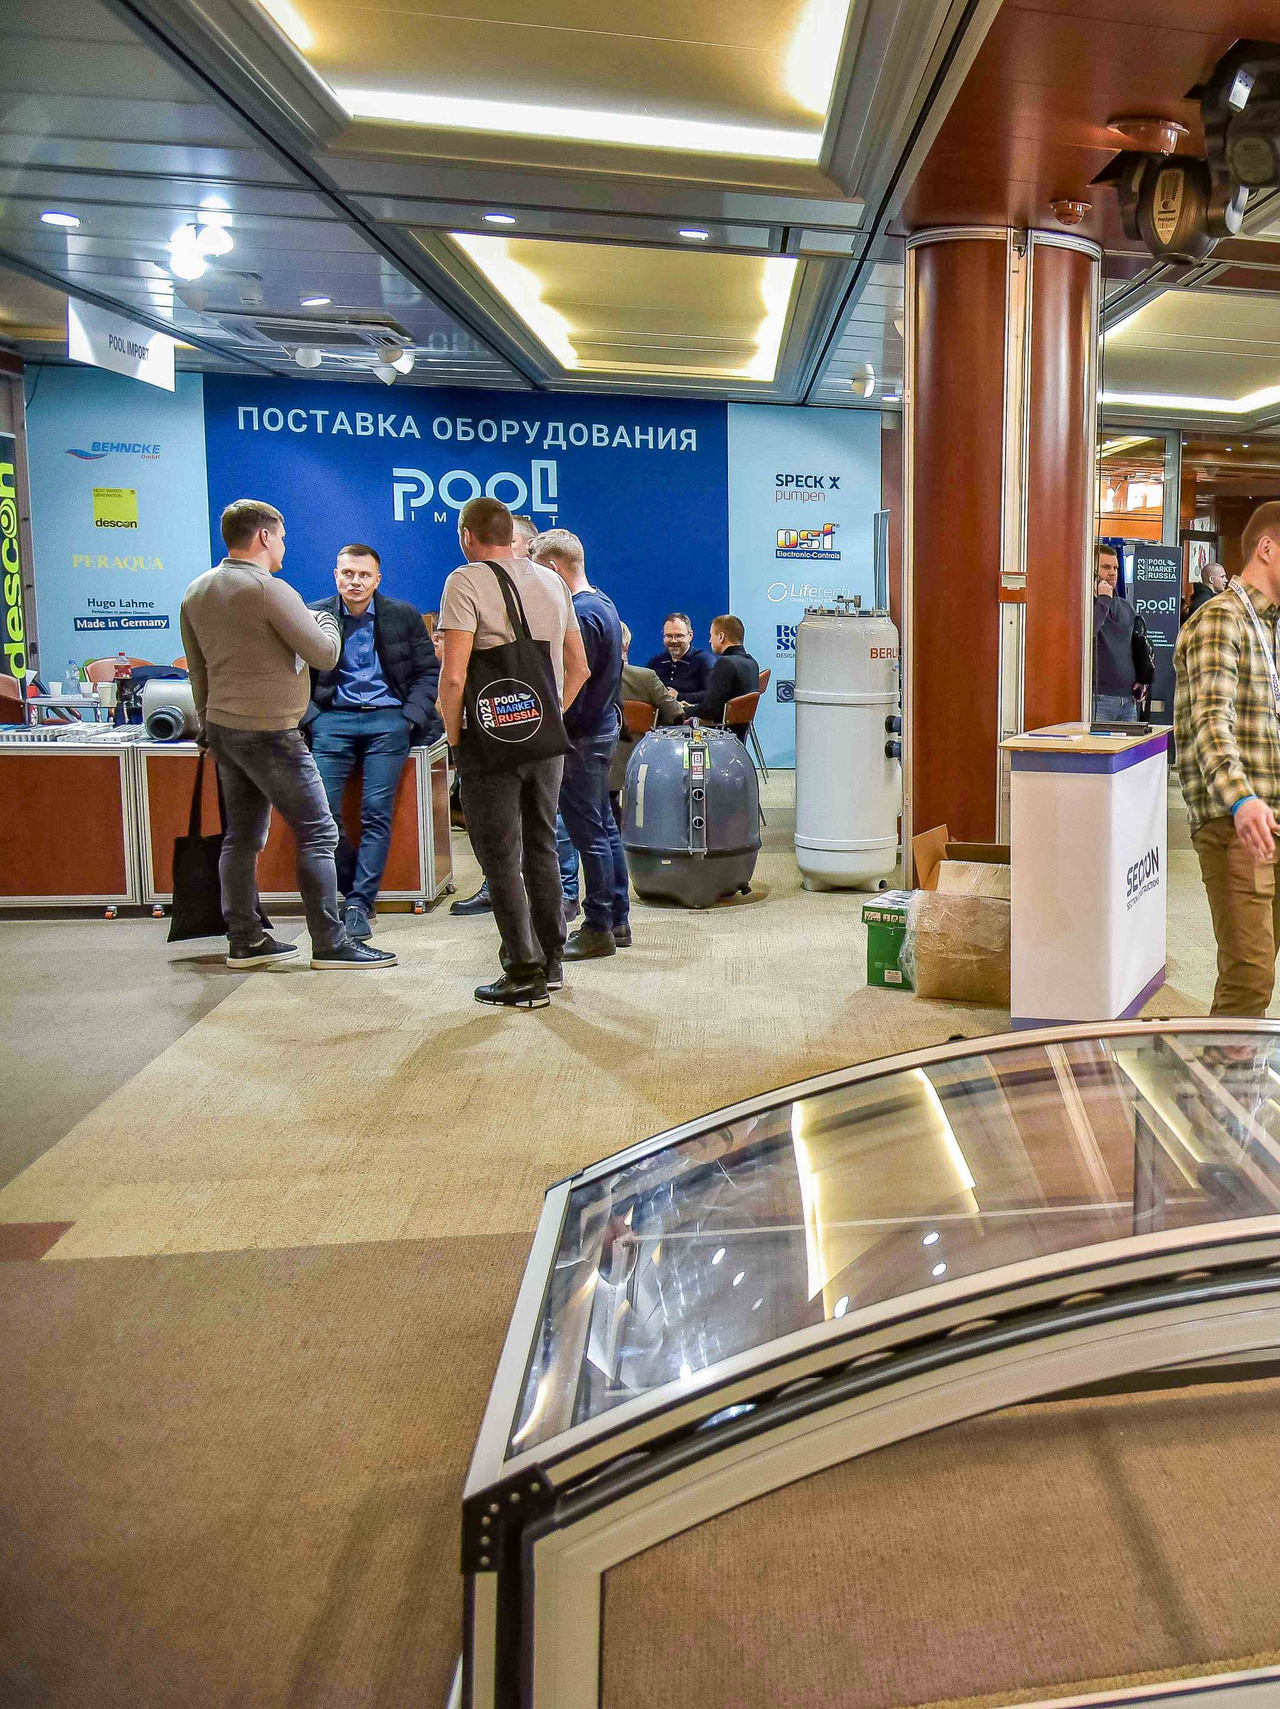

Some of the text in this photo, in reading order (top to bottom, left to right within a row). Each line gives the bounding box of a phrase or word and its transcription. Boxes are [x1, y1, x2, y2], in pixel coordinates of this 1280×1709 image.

[108, 333, 150, 361] POOL IMPORT
[238, 406, 697, 452] ПОСТАВКА ОБОРУДОВАНИЯ
[91, 441, 161, 455] BEHNCKE
[775, 473, 825, 489] SPECK
[775, 490, 826, 504] pumpen
[95, 518, 138, 528] descon
[776, 550, 840, 559] Electronic-Controls
[0, 461, 27, 680] descon
[72, 554, 164, 572] PERAQUA
[1137, 558, 1146, 581] 2023
[1148, 565, 1177, 573] MARKET
[1148, 572, 1177, 580] RUSSIA
[790, 583, 850, 598] Lifetech
[87, 598, 155, 610] Hugo Lahme
[76, 618, 168, 629] Made in Germany
[494, 694, 520, 706] POOL
[496, 699, 536, 715] MARKET
[479, 698, 495, 729] 2023
[497, 709, 540, 724] RUSSIA
